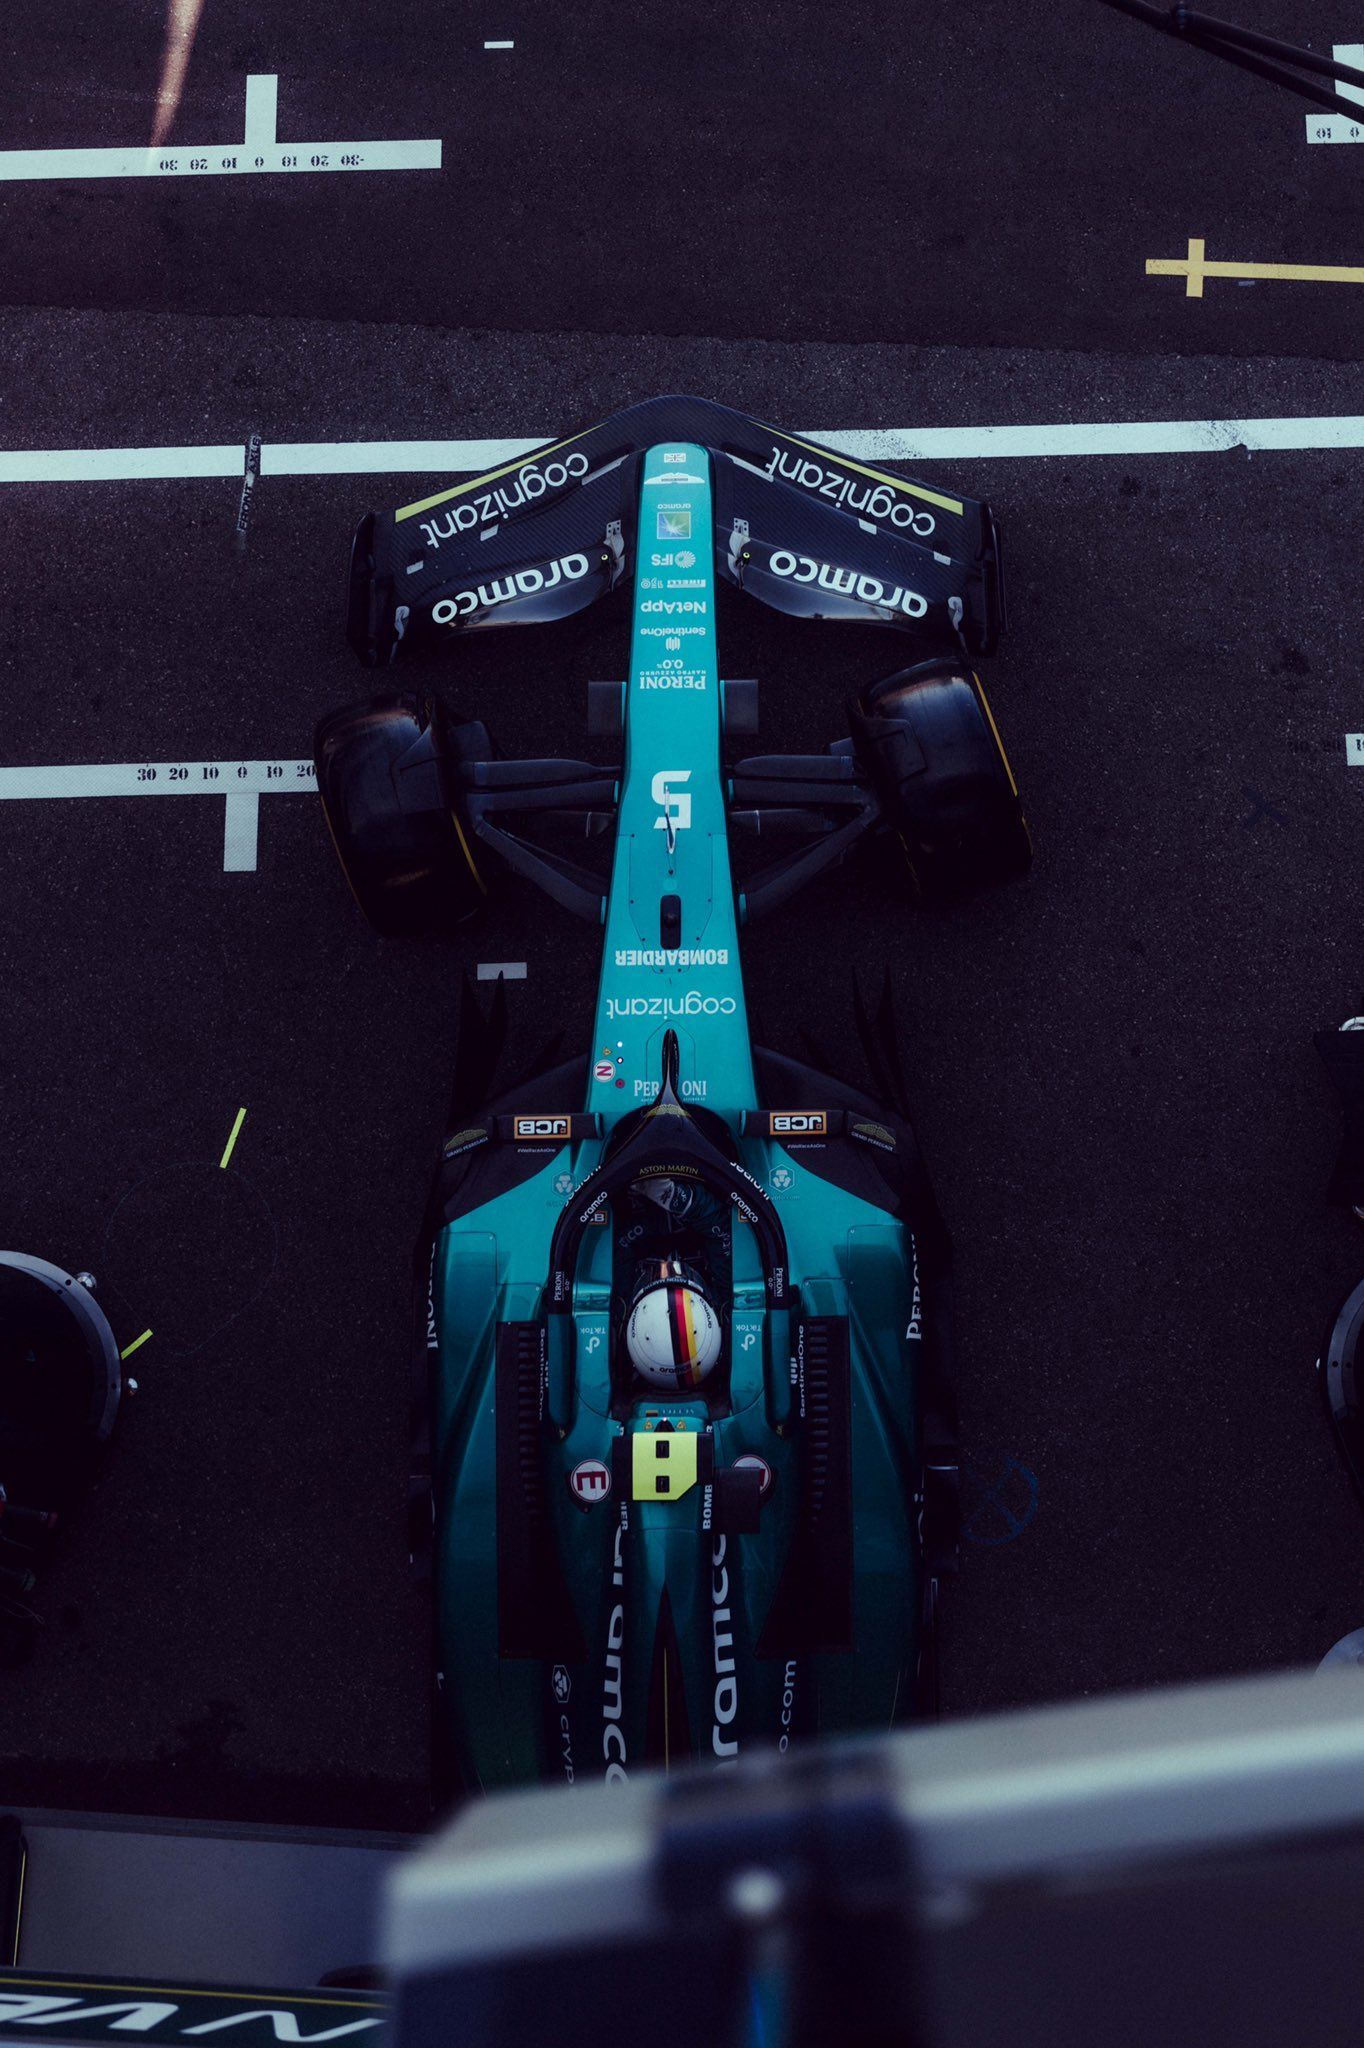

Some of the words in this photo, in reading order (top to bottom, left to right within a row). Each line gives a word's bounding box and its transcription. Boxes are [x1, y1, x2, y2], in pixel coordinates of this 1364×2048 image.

[160, 160, 178, 171] 30
[190, 159, 208, 170] 20
[222, 157, 237, 169] 10
[255, 157, 264, 167] 0
[282, 156, 298, 167] 10
[311, 155, 329, 166] 20
[765, 447, 935, 536] cognizant
[420, 453, 588, 548] cognizant
[651, 553, 674, 566] IFS
[431, 553, 589, 624] aramco
[770, 550, 928, 618] aramco
[641, 600, 706, 614] NetApp
[640, 627, 706, 636] SentinelOne
[640, 676, 706, 690] PERONI
[138, 769, 156, 780] 30
[169, 768, 188, 780] 20
[202, 767, 219, 779] 10
[237, 767, 247, 778] 0
[267, 766, 283, 778] 10
[297, 765, 316, 777] 20
[651, 770, 692, 829] 5
[615, 949, 728, 966] BOMBARDIER
[606, 990, 736, 1020] cognizant
[518, 1120, 567, 1135] JCB
[774, 1116, 822, 1131] JCB
[640, 1165, 665, 1176] ASTON
[667, 1165, 699, 1175] MARTIN
[580, 1191, 608, 1222] aramco
[731, 1192, 758, 1223] aramco
[554, 1271, 562, 1301] PERONI
[776, 1267, 784, 1297] PERONI
[580, 1326, 606, 1335] TikTok
[736, 1324, 761, 1332] TikTok
[576, 1471, 606, 1491] E
